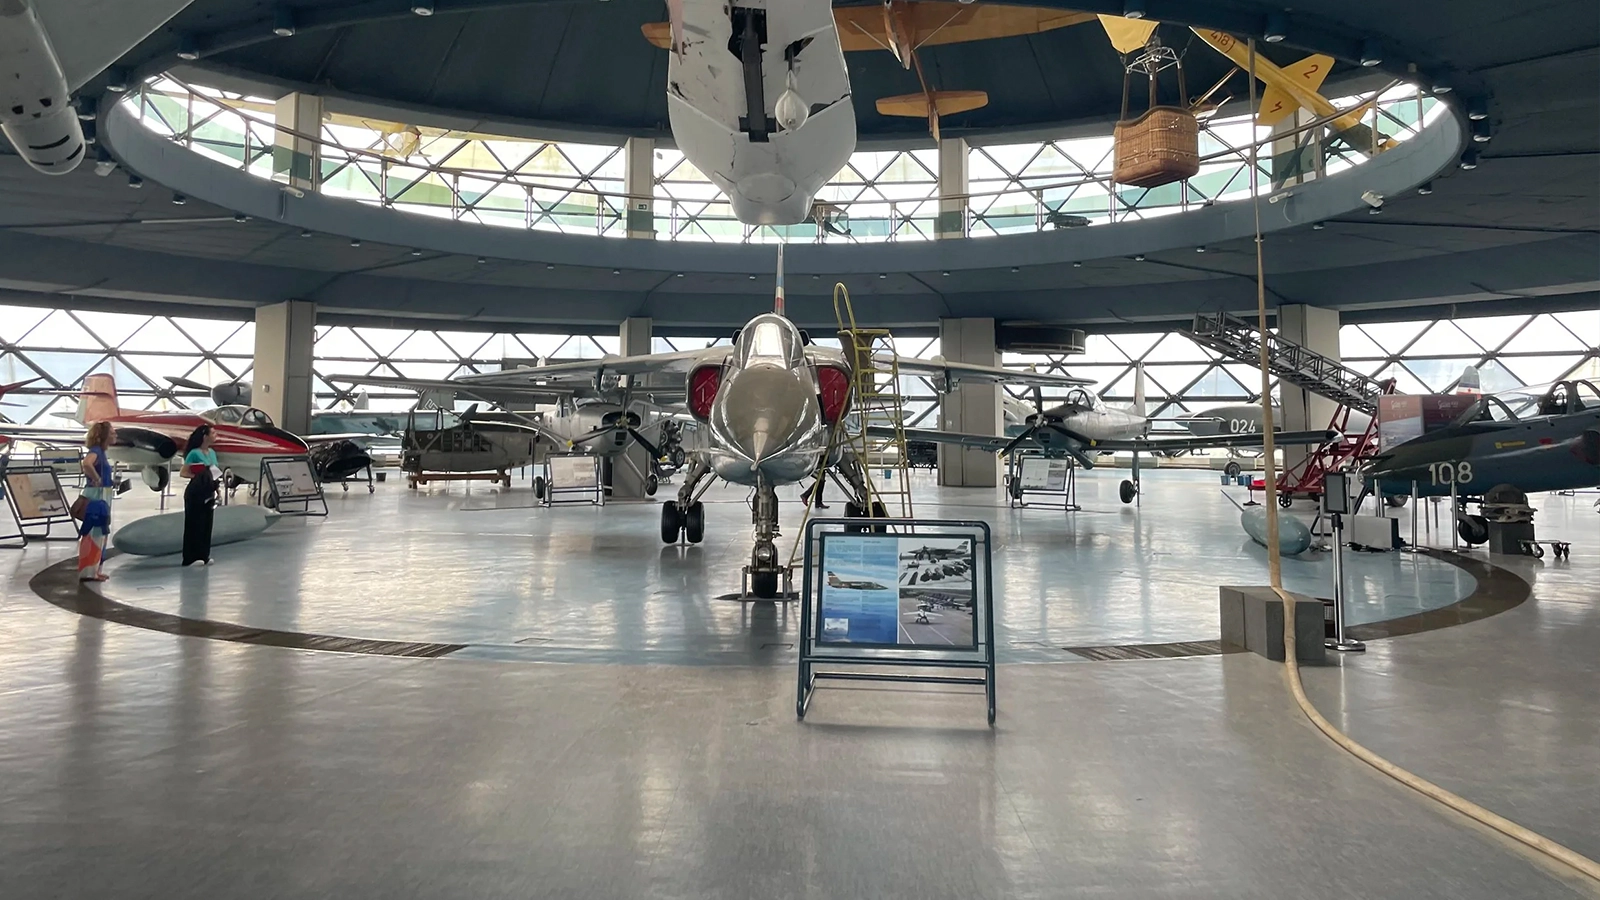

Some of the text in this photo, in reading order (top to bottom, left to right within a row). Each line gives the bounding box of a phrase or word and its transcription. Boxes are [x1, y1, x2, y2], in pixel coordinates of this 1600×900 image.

[1303, 64, 1319, 79] 2
[1230, 418, 1256, 434] 024
[1428, 461, 1473, 486] 108
